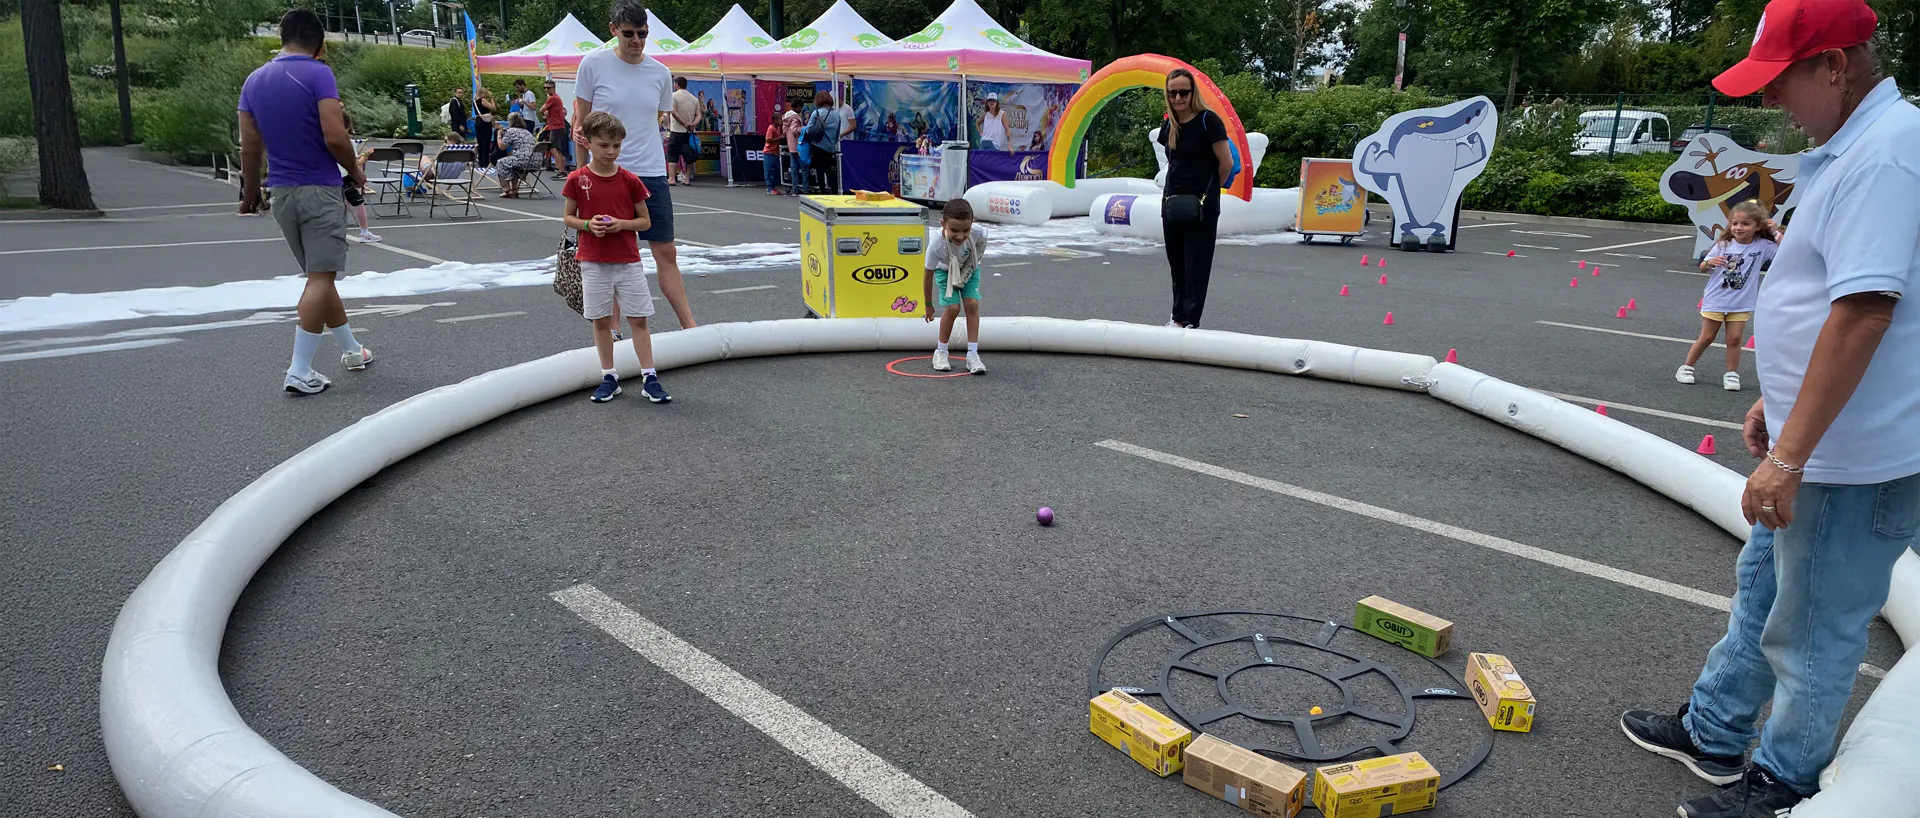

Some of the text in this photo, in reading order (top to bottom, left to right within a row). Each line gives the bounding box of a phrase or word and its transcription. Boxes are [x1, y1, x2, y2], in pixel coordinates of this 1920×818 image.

[745, 150, 764, 161] BE
[863, 267, 897, 280] OBUT
[1383, 621, 1408, 636] OBUT
